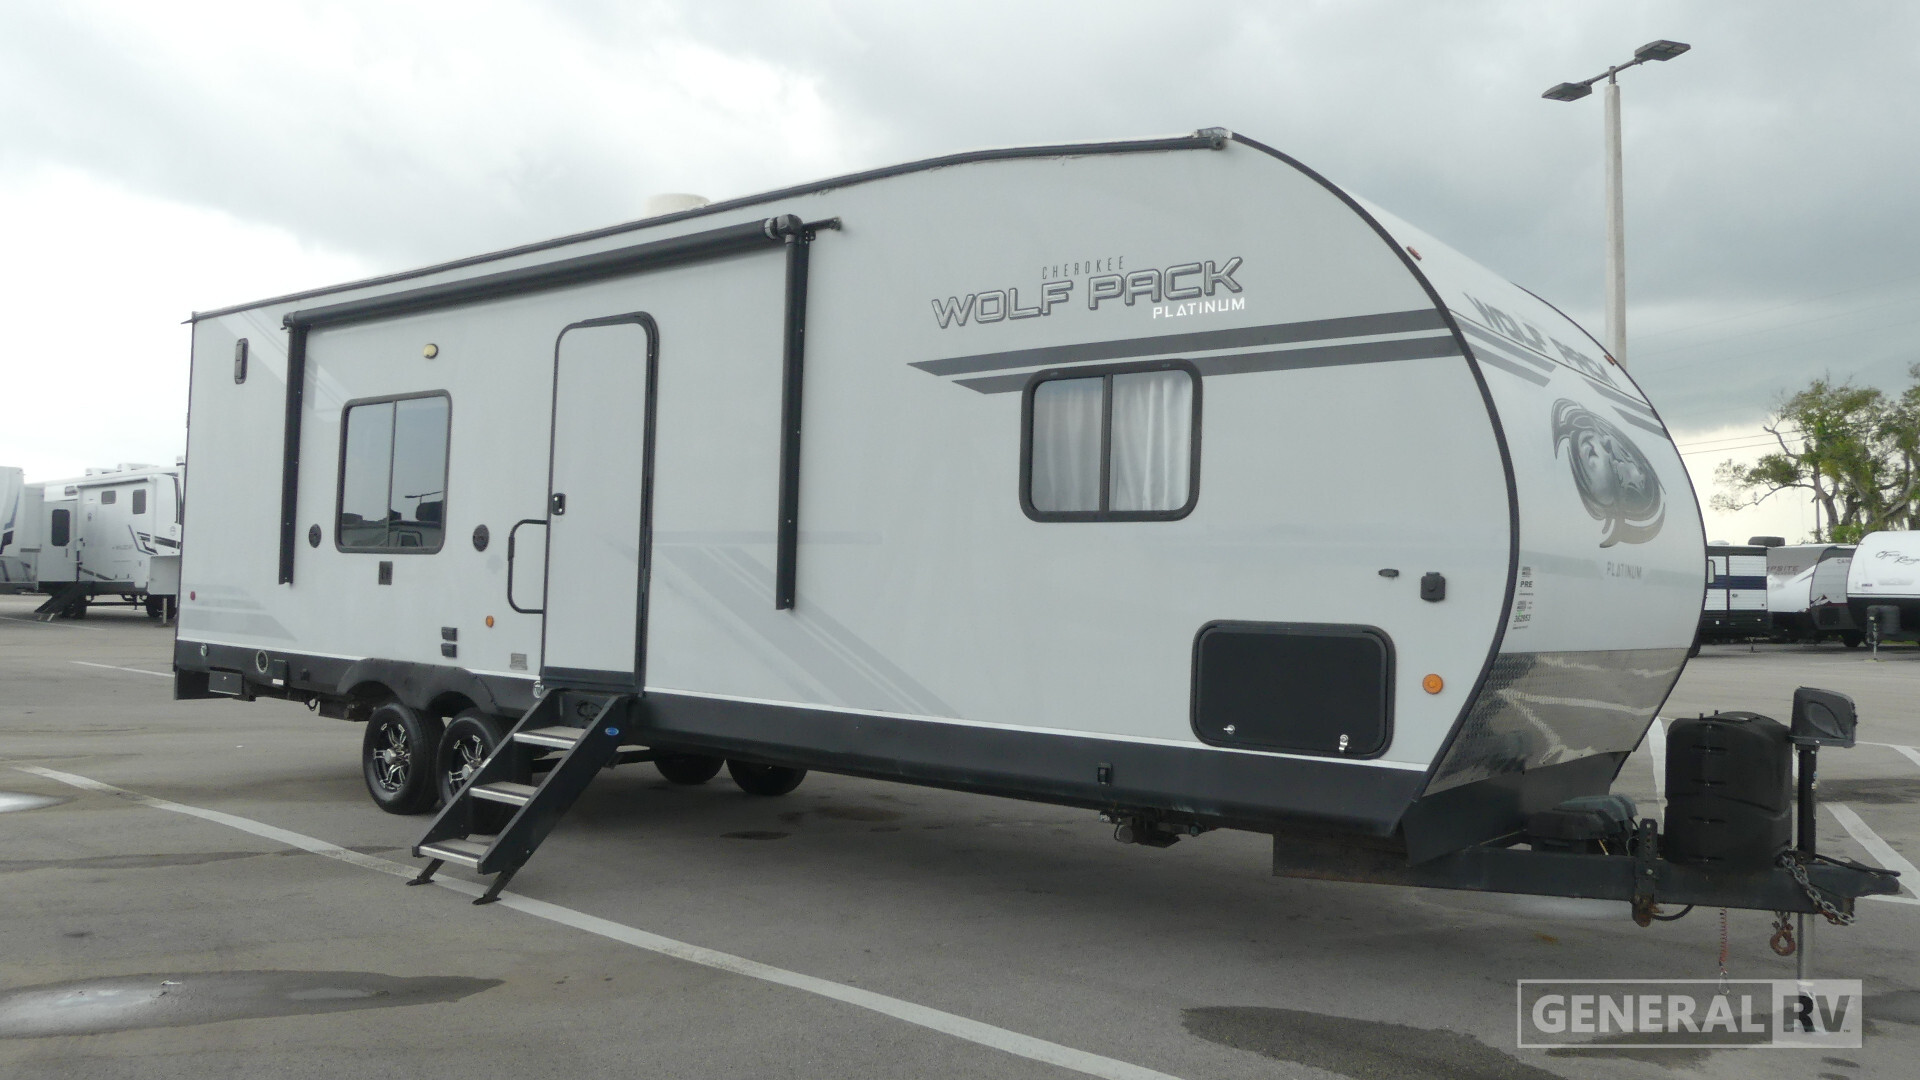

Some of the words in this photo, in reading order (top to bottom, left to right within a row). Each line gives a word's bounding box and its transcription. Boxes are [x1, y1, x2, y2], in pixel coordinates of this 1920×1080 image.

[1042, 255, 1124, 280] CHEROKEE
[931, 279, 1074, 329] WOLF
[1088, 256, 1243, 310] PACK
[1152, 297, 1245, 319] PLATINUM
[1606, 561, 1642, 580] PLATINUM
[1520, 580, 1533, 588] PRE
